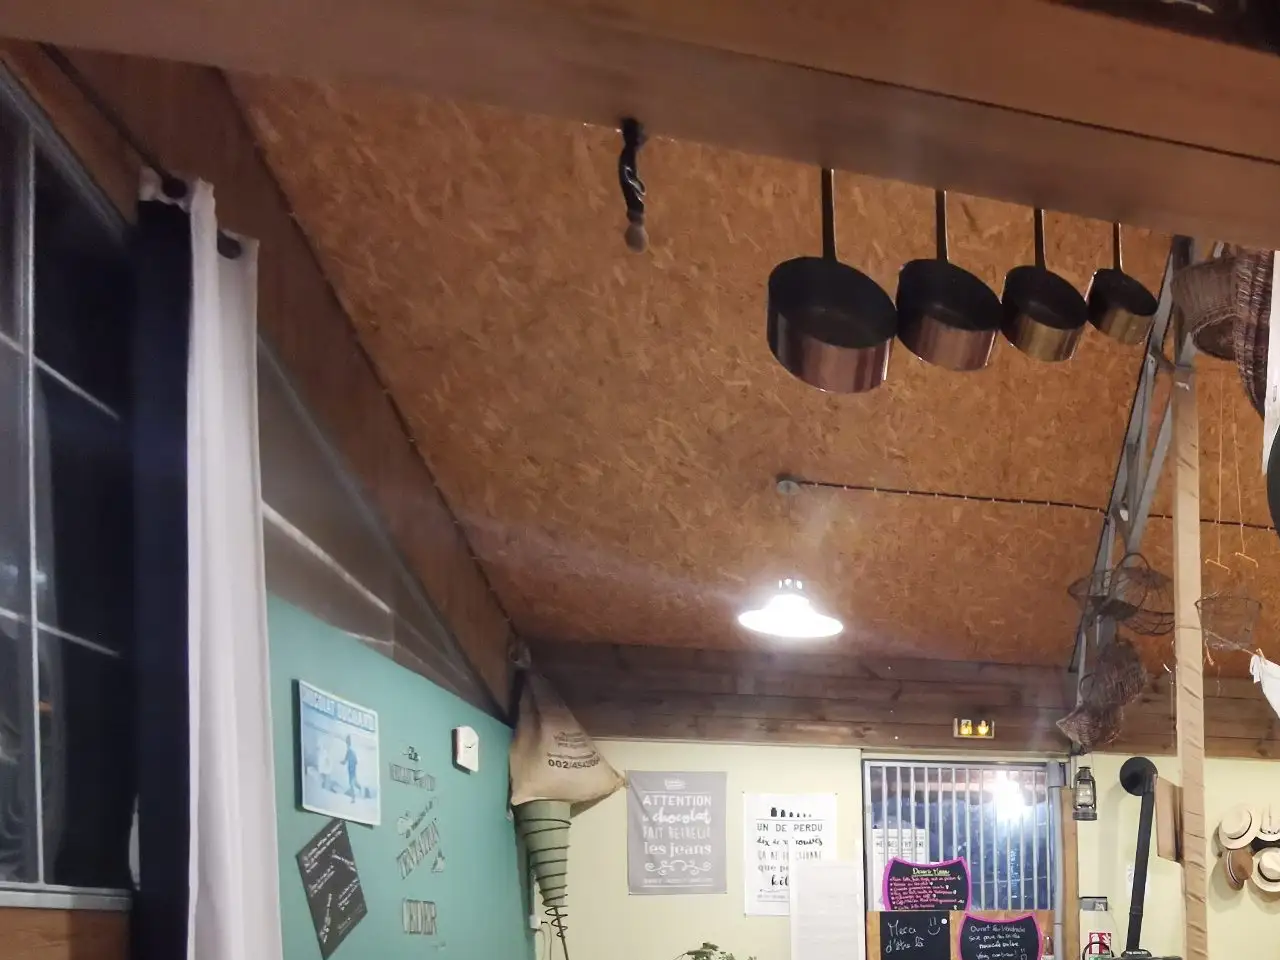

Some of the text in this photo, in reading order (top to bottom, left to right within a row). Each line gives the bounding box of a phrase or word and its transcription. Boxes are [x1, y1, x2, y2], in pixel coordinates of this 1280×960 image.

[642, 795, 713, 807] ATTENTION
[652, 806, 713, 825] chocolat
[756, 823, 823, 832] UN DE PERDU
[643, 841, 713, 858] les jeans
